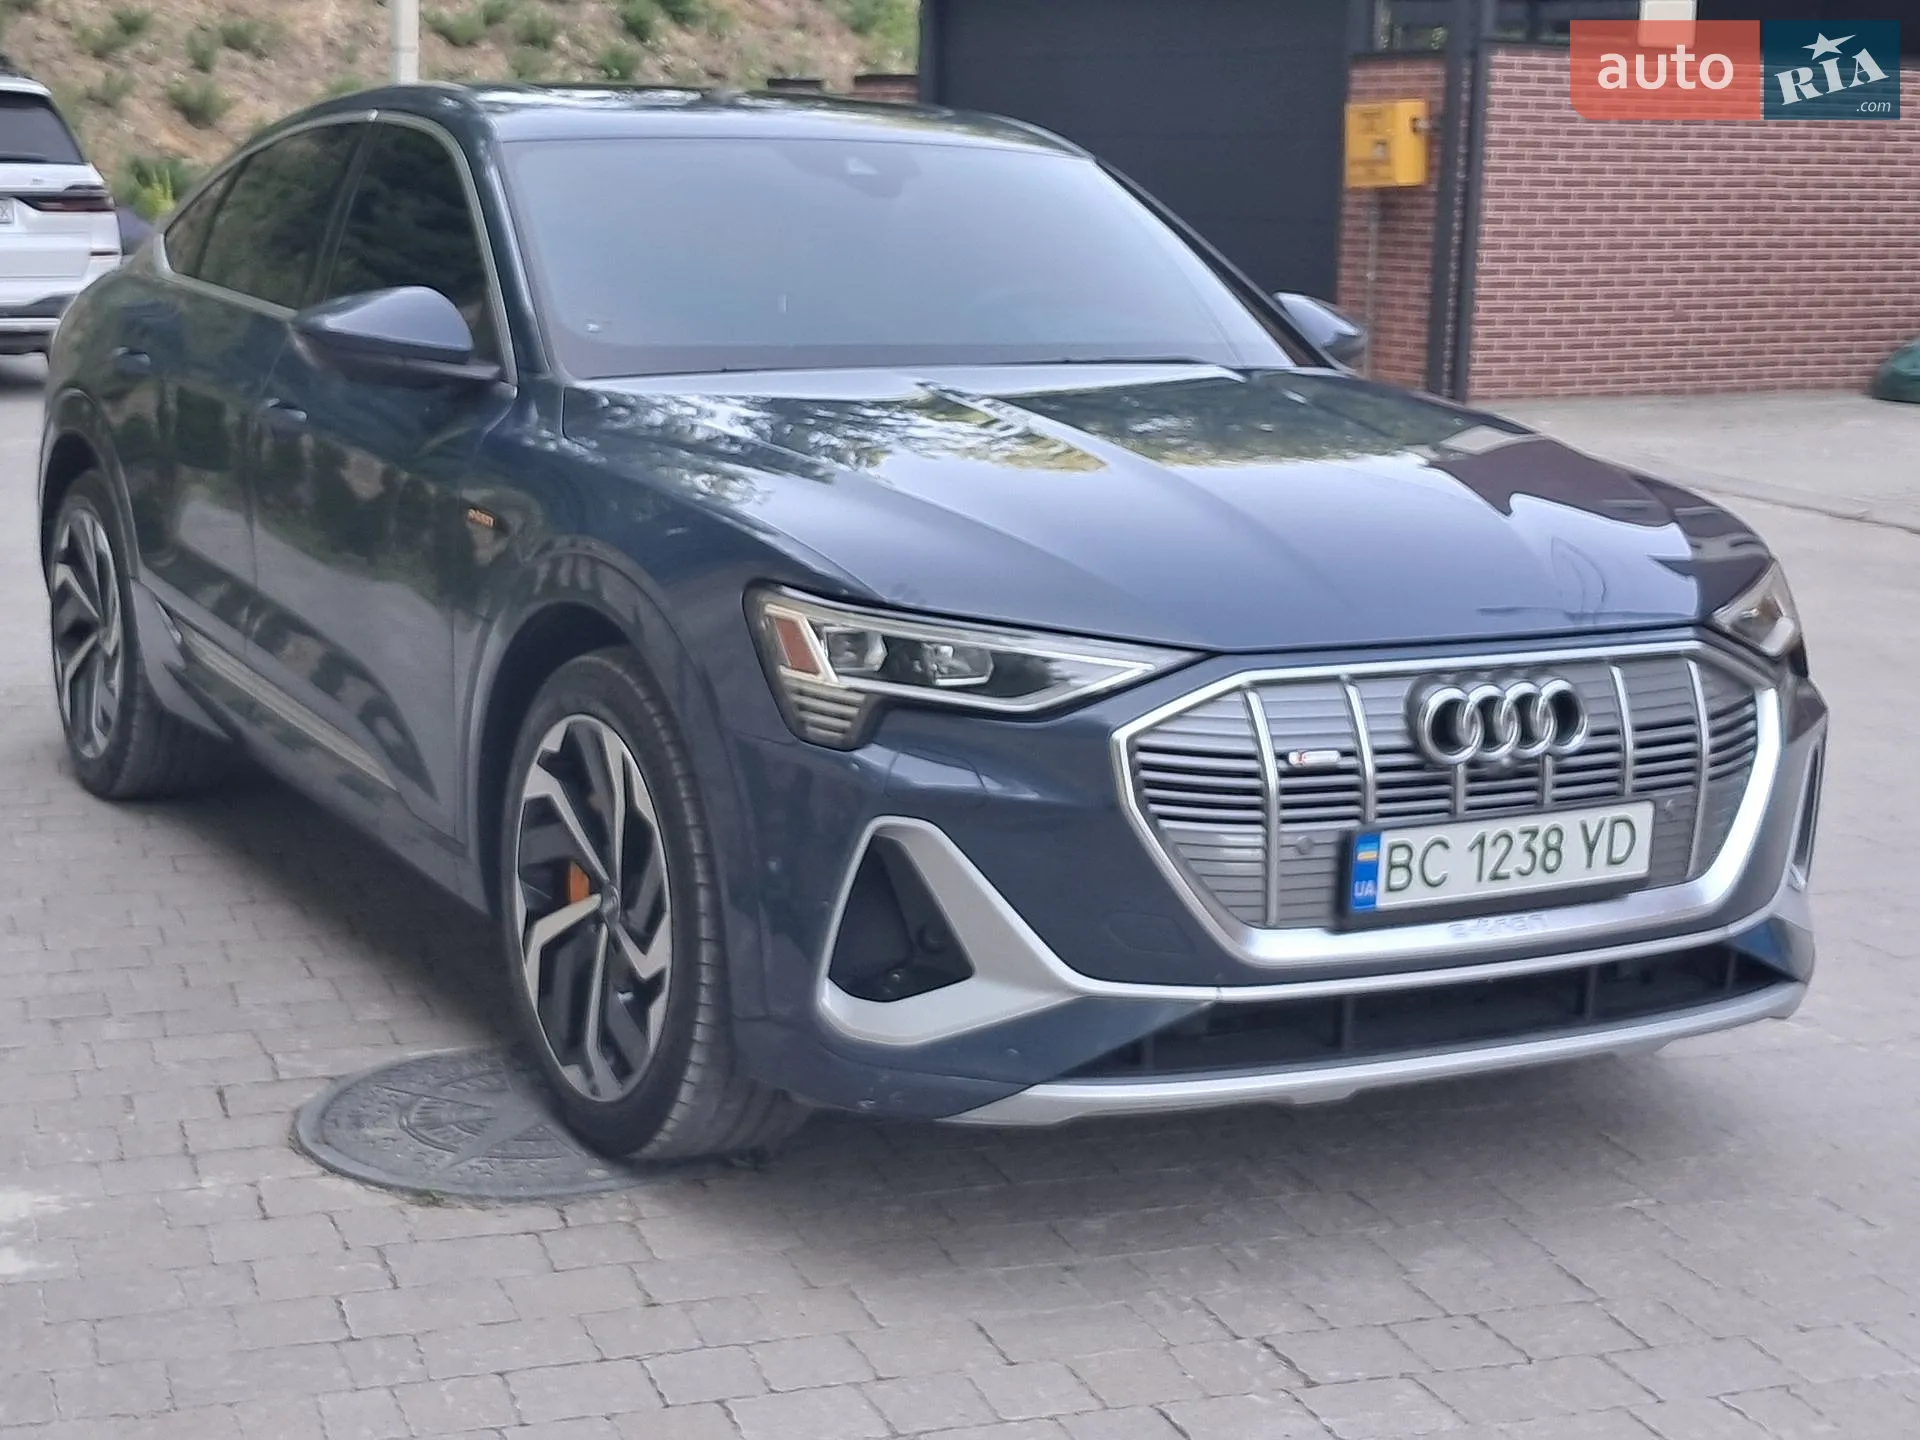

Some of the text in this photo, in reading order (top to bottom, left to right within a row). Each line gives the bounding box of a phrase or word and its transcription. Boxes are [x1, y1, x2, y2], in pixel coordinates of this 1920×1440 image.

[1385, 813, 1638, 893] BC 1238 YD
[1353, 879, 1375, 898] UA
